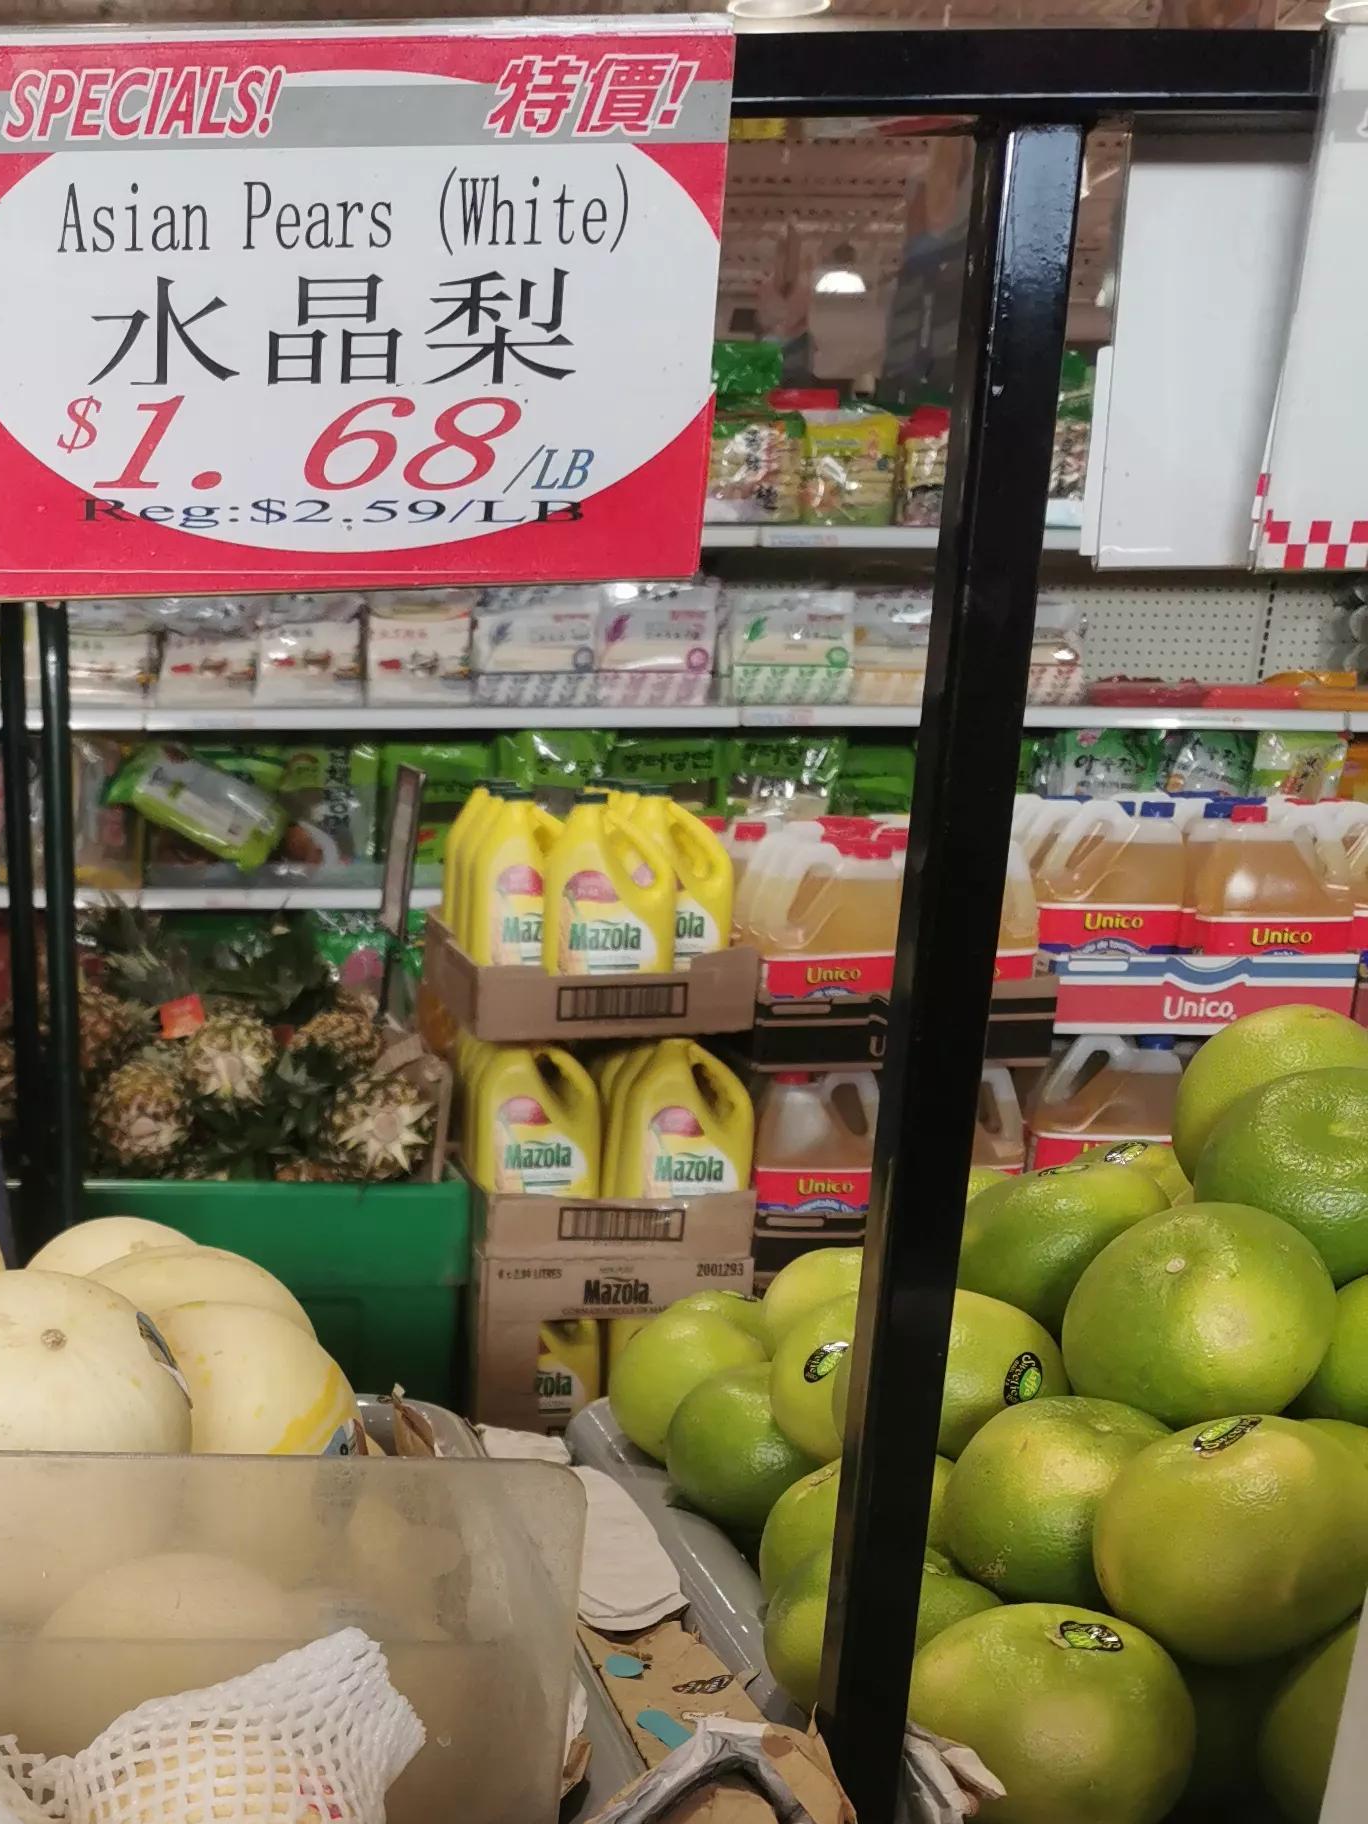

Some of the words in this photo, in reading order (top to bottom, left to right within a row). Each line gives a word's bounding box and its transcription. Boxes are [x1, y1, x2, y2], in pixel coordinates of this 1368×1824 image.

[1, 66, 283, 142] SPECIALS!
[483, 52, 698, 139] 特價!
[57, 182, 209, 254] Asian
[242, 181, 393, 251] Pears
[439, 164, 631, 256] (White)
[88, 267, 577, 386] 水晶梨
[77, 497, 584, 529] Reg:$2.59/LB
[502, 917, 543, 944] Maz
[676, 911, 705, 938] ola
[1084, 912, 1144, 930] Unico
[569, 922, 642, 951] Mazola
[1251, 928, 1313, 946] Unico
[806, 967, 862, 984] Unico
[1163, 996, 1235, 1020] Unico
[504, 1143, 573, 1169] Mazola
[653, 1154, 724, 1182] Mazola
[797, 1178, 855, 1195] Unico
[696, 1263, 744, 1277] 2001293
[584, 1277, 650, 1304] Mazola
[537, 1372, 572, 1397] zola
